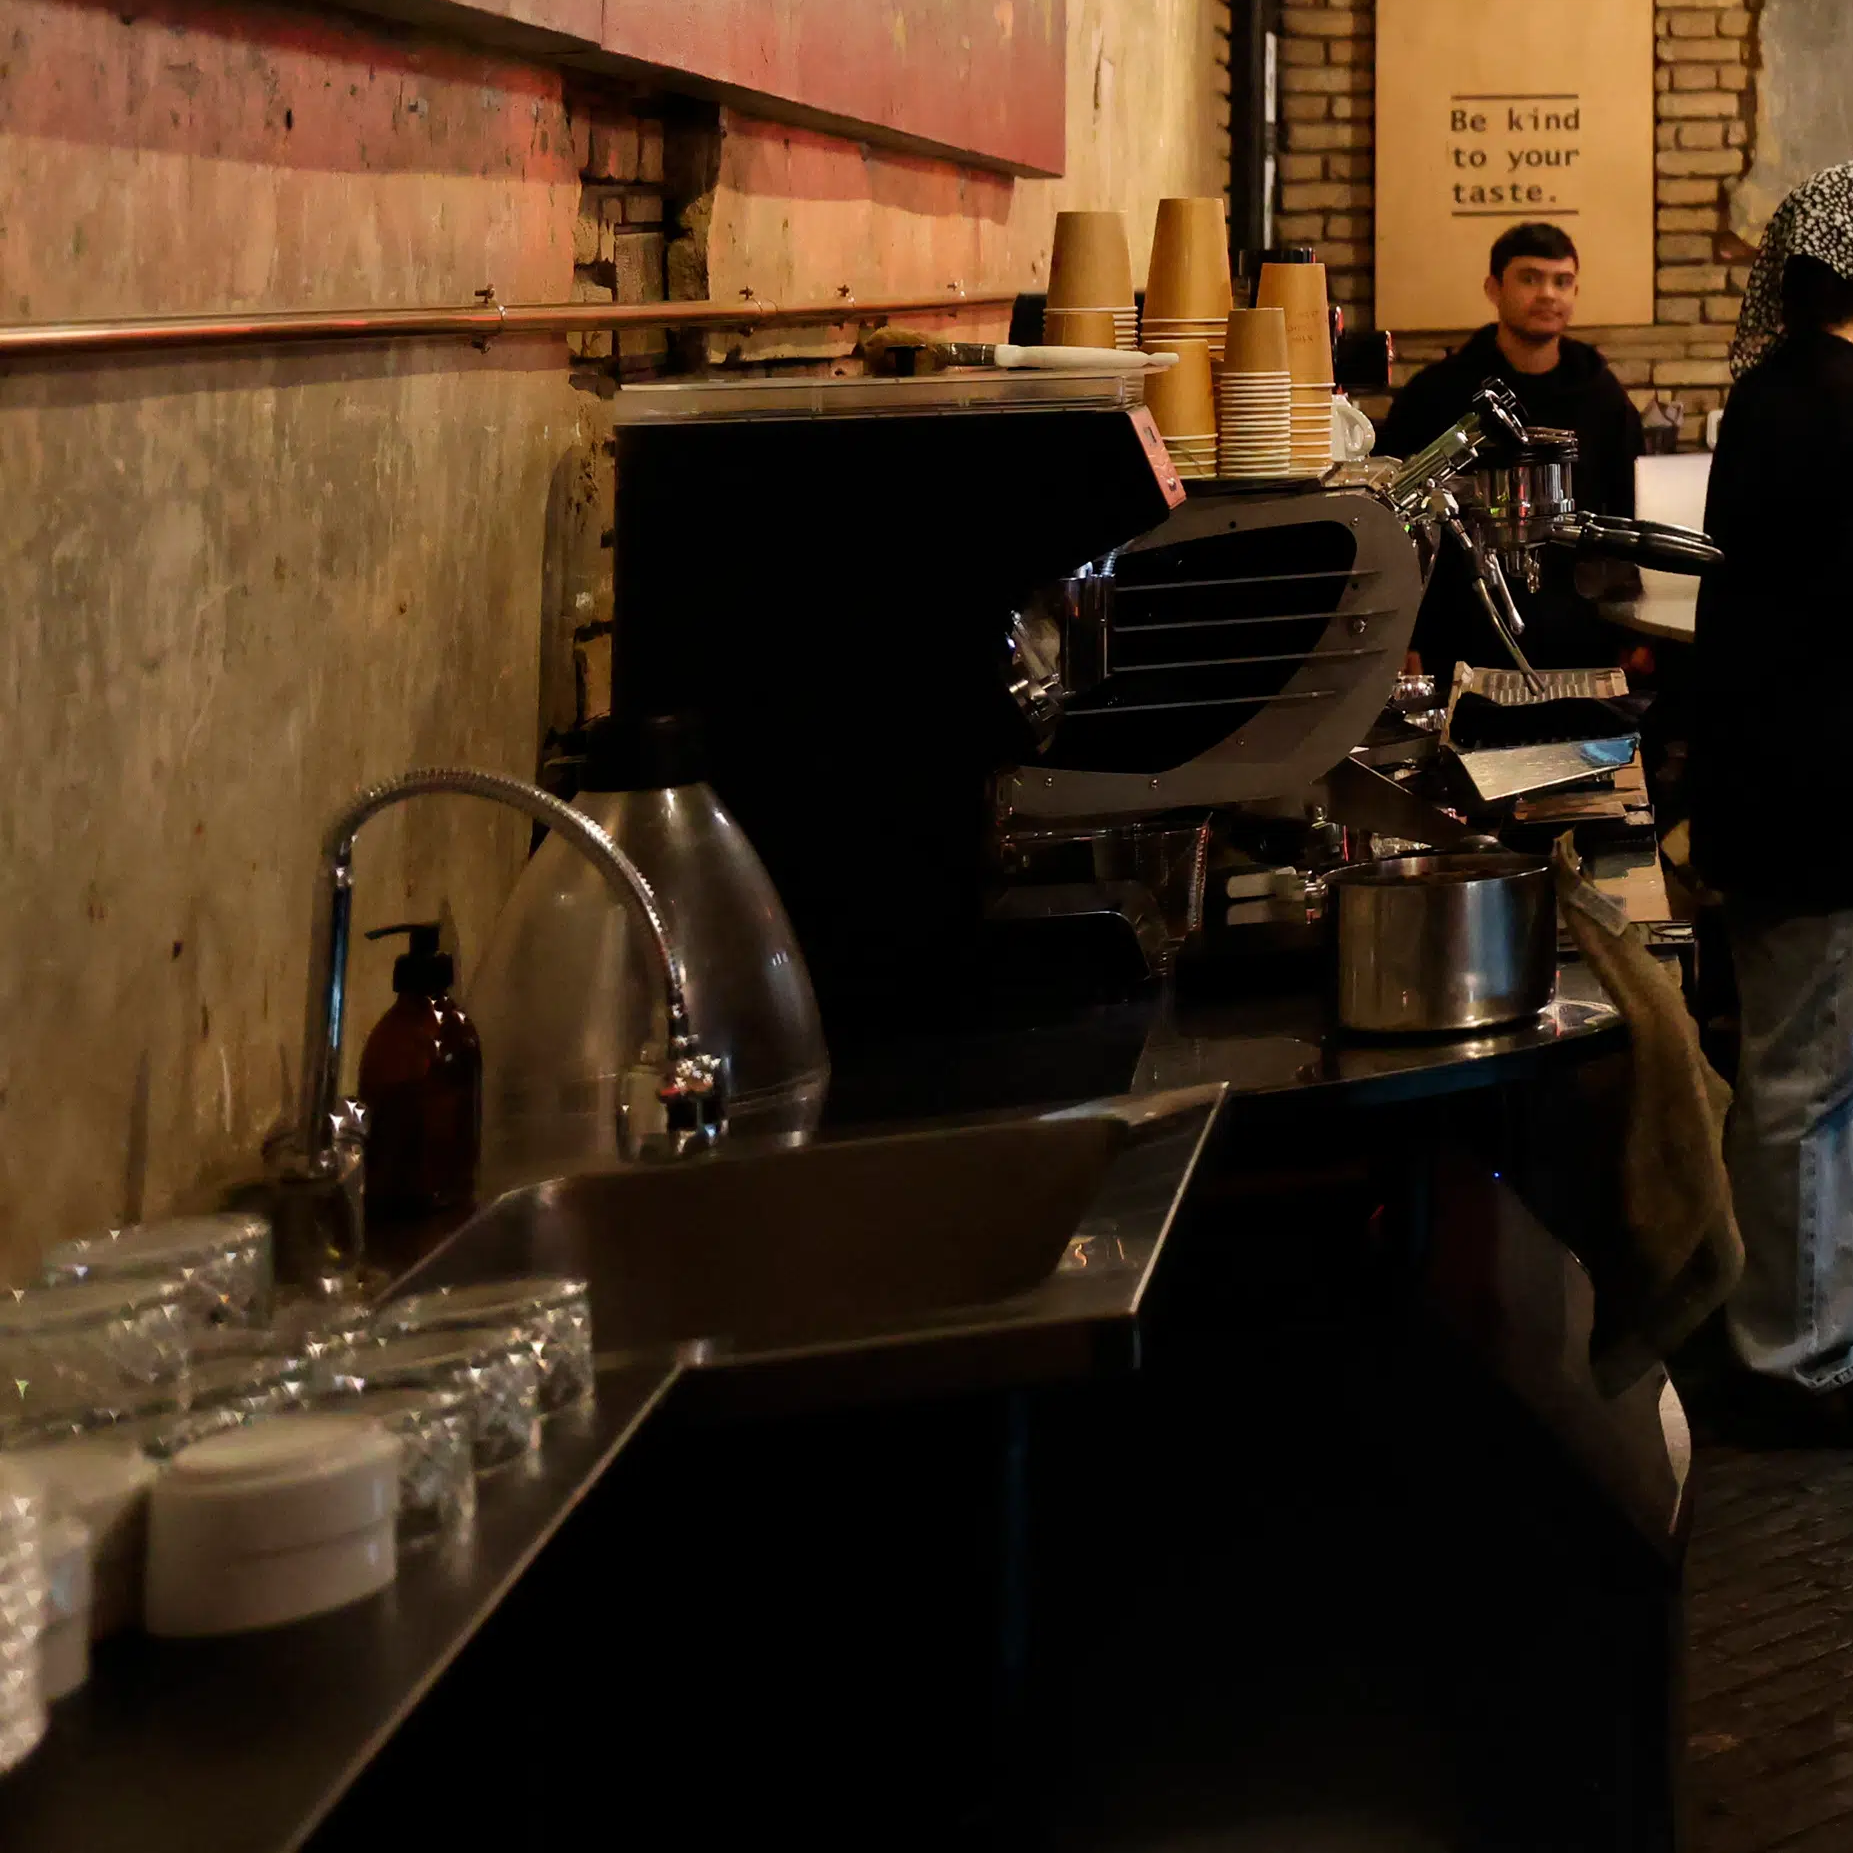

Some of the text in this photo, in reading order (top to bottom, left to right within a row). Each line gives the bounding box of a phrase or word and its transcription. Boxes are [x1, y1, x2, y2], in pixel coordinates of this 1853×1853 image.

[1450, 106, 1580, 132] Be kind
[1453, 148, 1580, 172] to your
[1452, 182, 1556, 204] taste.
